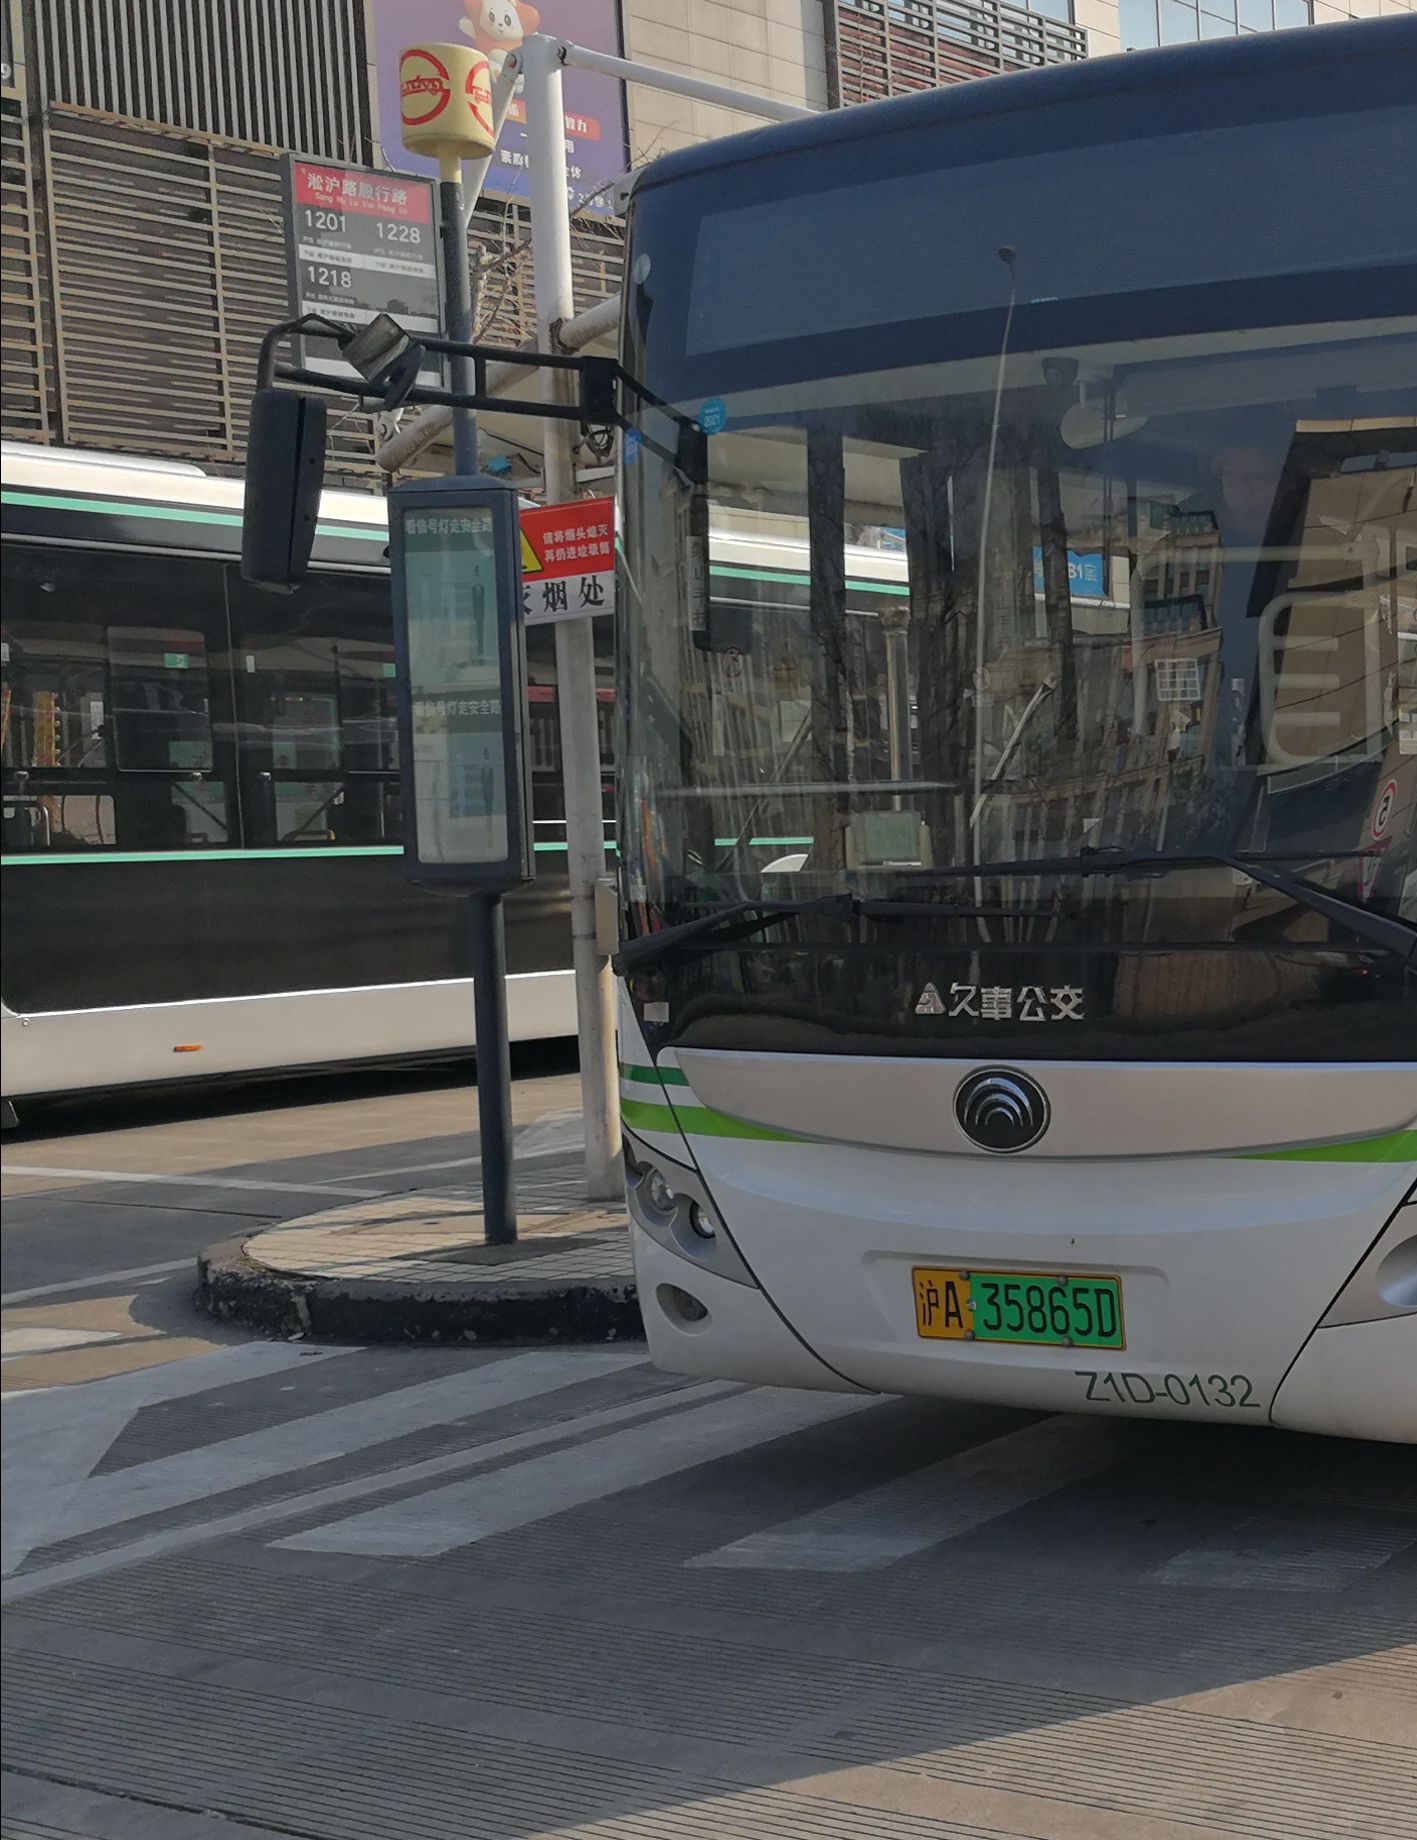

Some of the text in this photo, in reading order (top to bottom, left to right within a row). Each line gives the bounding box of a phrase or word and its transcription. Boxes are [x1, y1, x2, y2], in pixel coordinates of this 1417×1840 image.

[307, 173, 408, 205] 淞沪路殷行路
[315, 191, 333, 203] Song
[304, 209, 346, 233] 1201
[376, 222, 421, 244] 1228
[308, 266, 352, 288] 1218
[543, 524, 608, 545] 请将烟头熄灭
[1074, 1370, 1262, 1409] Z1D-0132
